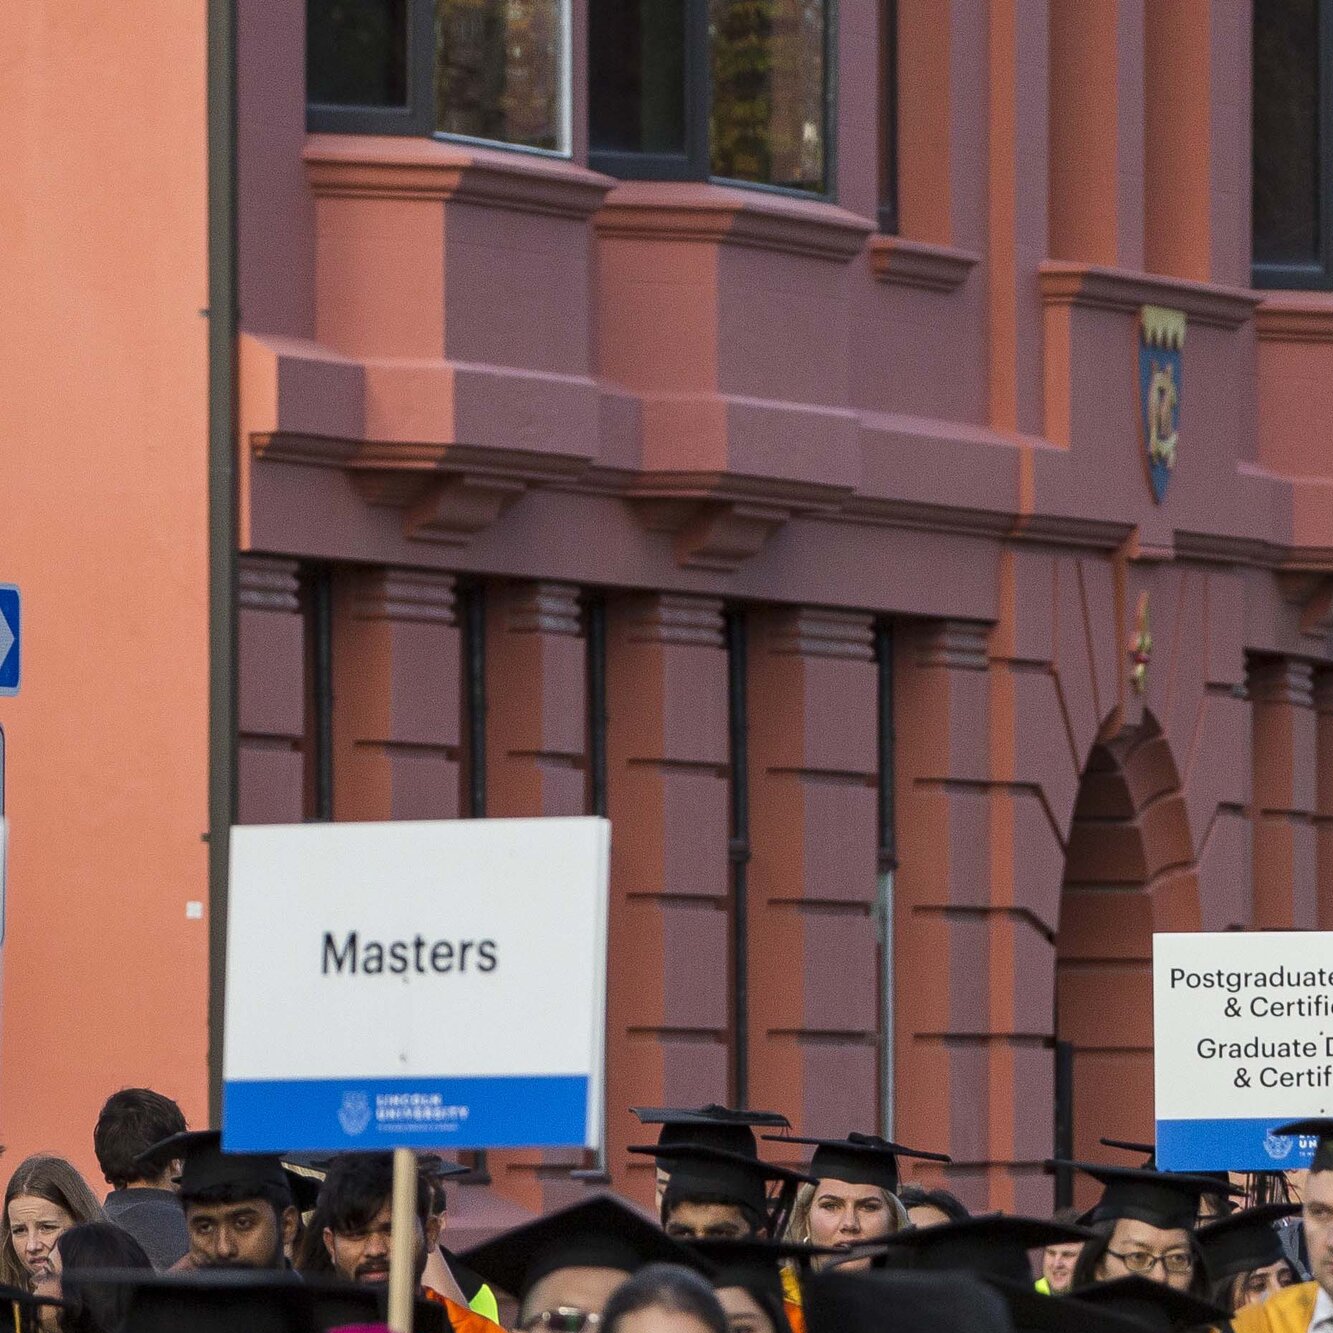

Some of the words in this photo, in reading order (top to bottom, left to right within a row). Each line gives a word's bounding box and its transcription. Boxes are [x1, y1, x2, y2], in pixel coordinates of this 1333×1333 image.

[322, 930, 498, 975] Masters
[1224, 997, 1242, 1018] &
[1197, 1036, 1317, 1059] Graduate
[1233, 1067, 1251, 1088] &
